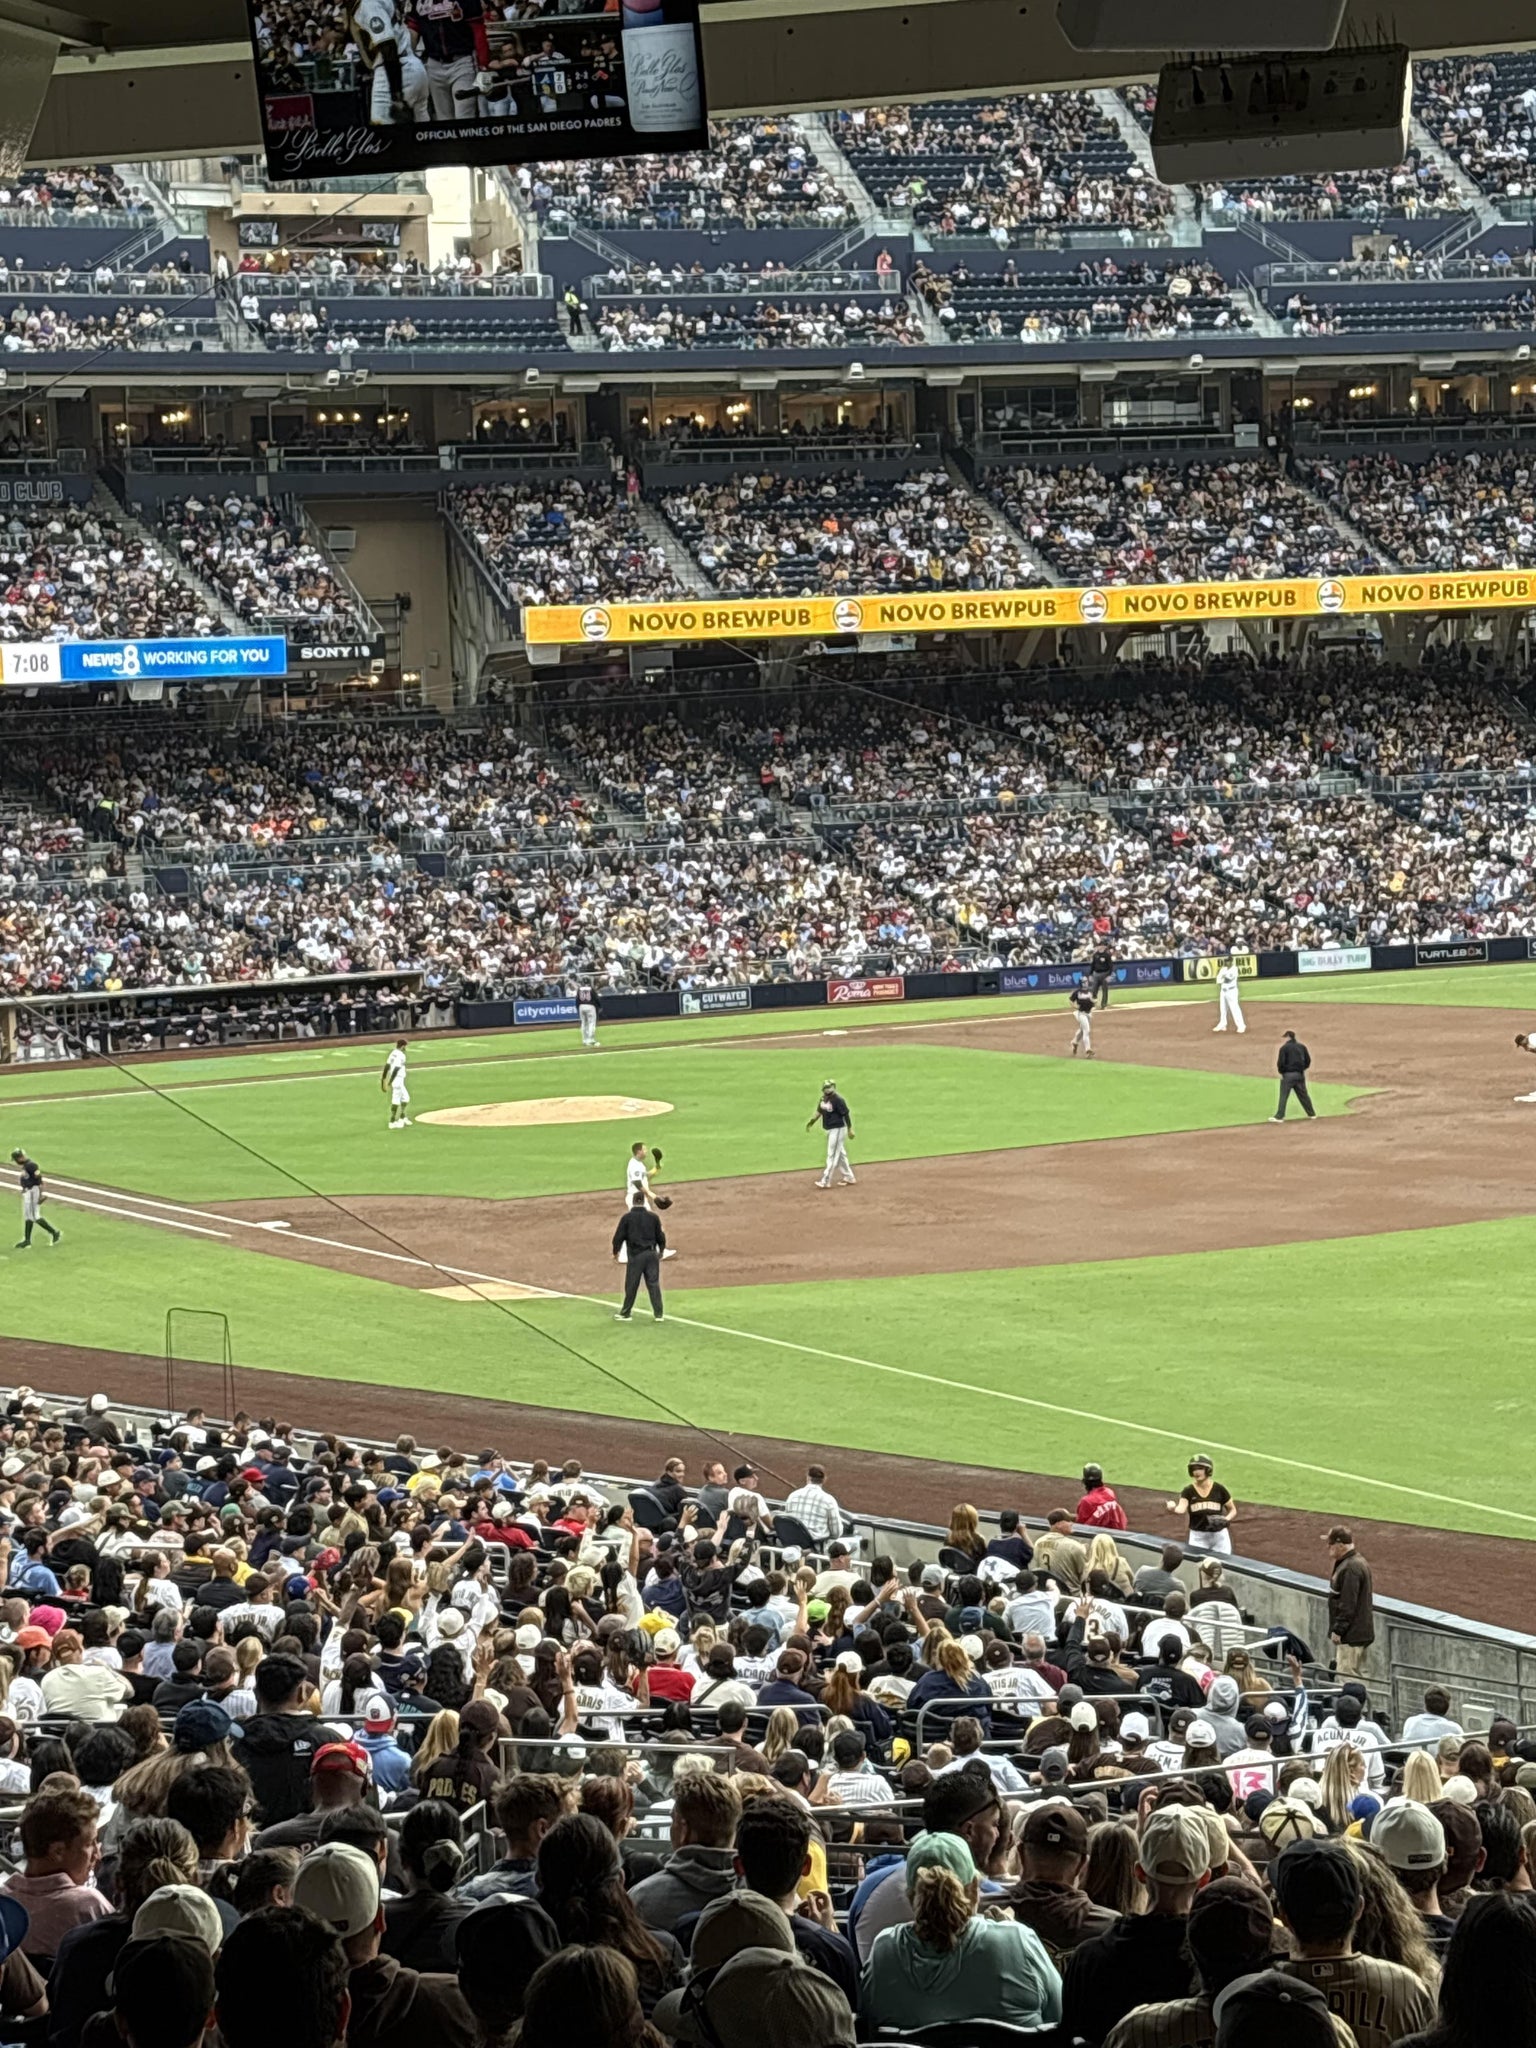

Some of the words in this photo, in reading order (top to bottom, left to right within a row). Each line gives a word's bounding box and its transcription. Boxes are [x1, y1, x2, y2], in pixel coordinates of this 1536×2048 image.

[415, 129, 457, 141] OFFICIAL
[459, 126, 490, 138] WINES
[491, 126, 504, 136] OF
[507, 124, 525, 134] THE
[527, 122, 548, 133] SAN
[550, 119, 582, 131] DIEGO
[584, 116, 622, 128] PADRES
[14, 481, 63, 501] CLUB
[1124, 593, 1189, 613] NOVO
[1194, 589, 1297, 610] BREWPUB
[1361, 583, 1424, 604] NOVO
[1429, 580, 1530, 601] BREWPUB
[628, 611, 697, 633] NOVO
[702, 608, 812, 630] BREWPUB
[879, 602, 946, 624] NOVO
[951, 598, 1058, 620] BREWPUB
[82, 652, 124, 668] NEWS
[142, 650, 207, 666] WORKING
[210, 649, 238, 664] FOR
[240, 648, 270, 663] YOU
[300, 646, 352, 659] SONY
[12, 654, 49, 673] 7:08
[1419, 946, 1483, 959] TURTLEBOX
[1003, 976, 1028, 986] blue
[1136, 967, 1161, 978] blue
[702, 990, 747, 1003] CUTWATER
[832, 985, 872, 1001] Roma
[576, 1694, 604, 1710] ARRIS
[426, 1777, 478, 1806] PADES
[1328, 1989, 1388, 2034] RILL
